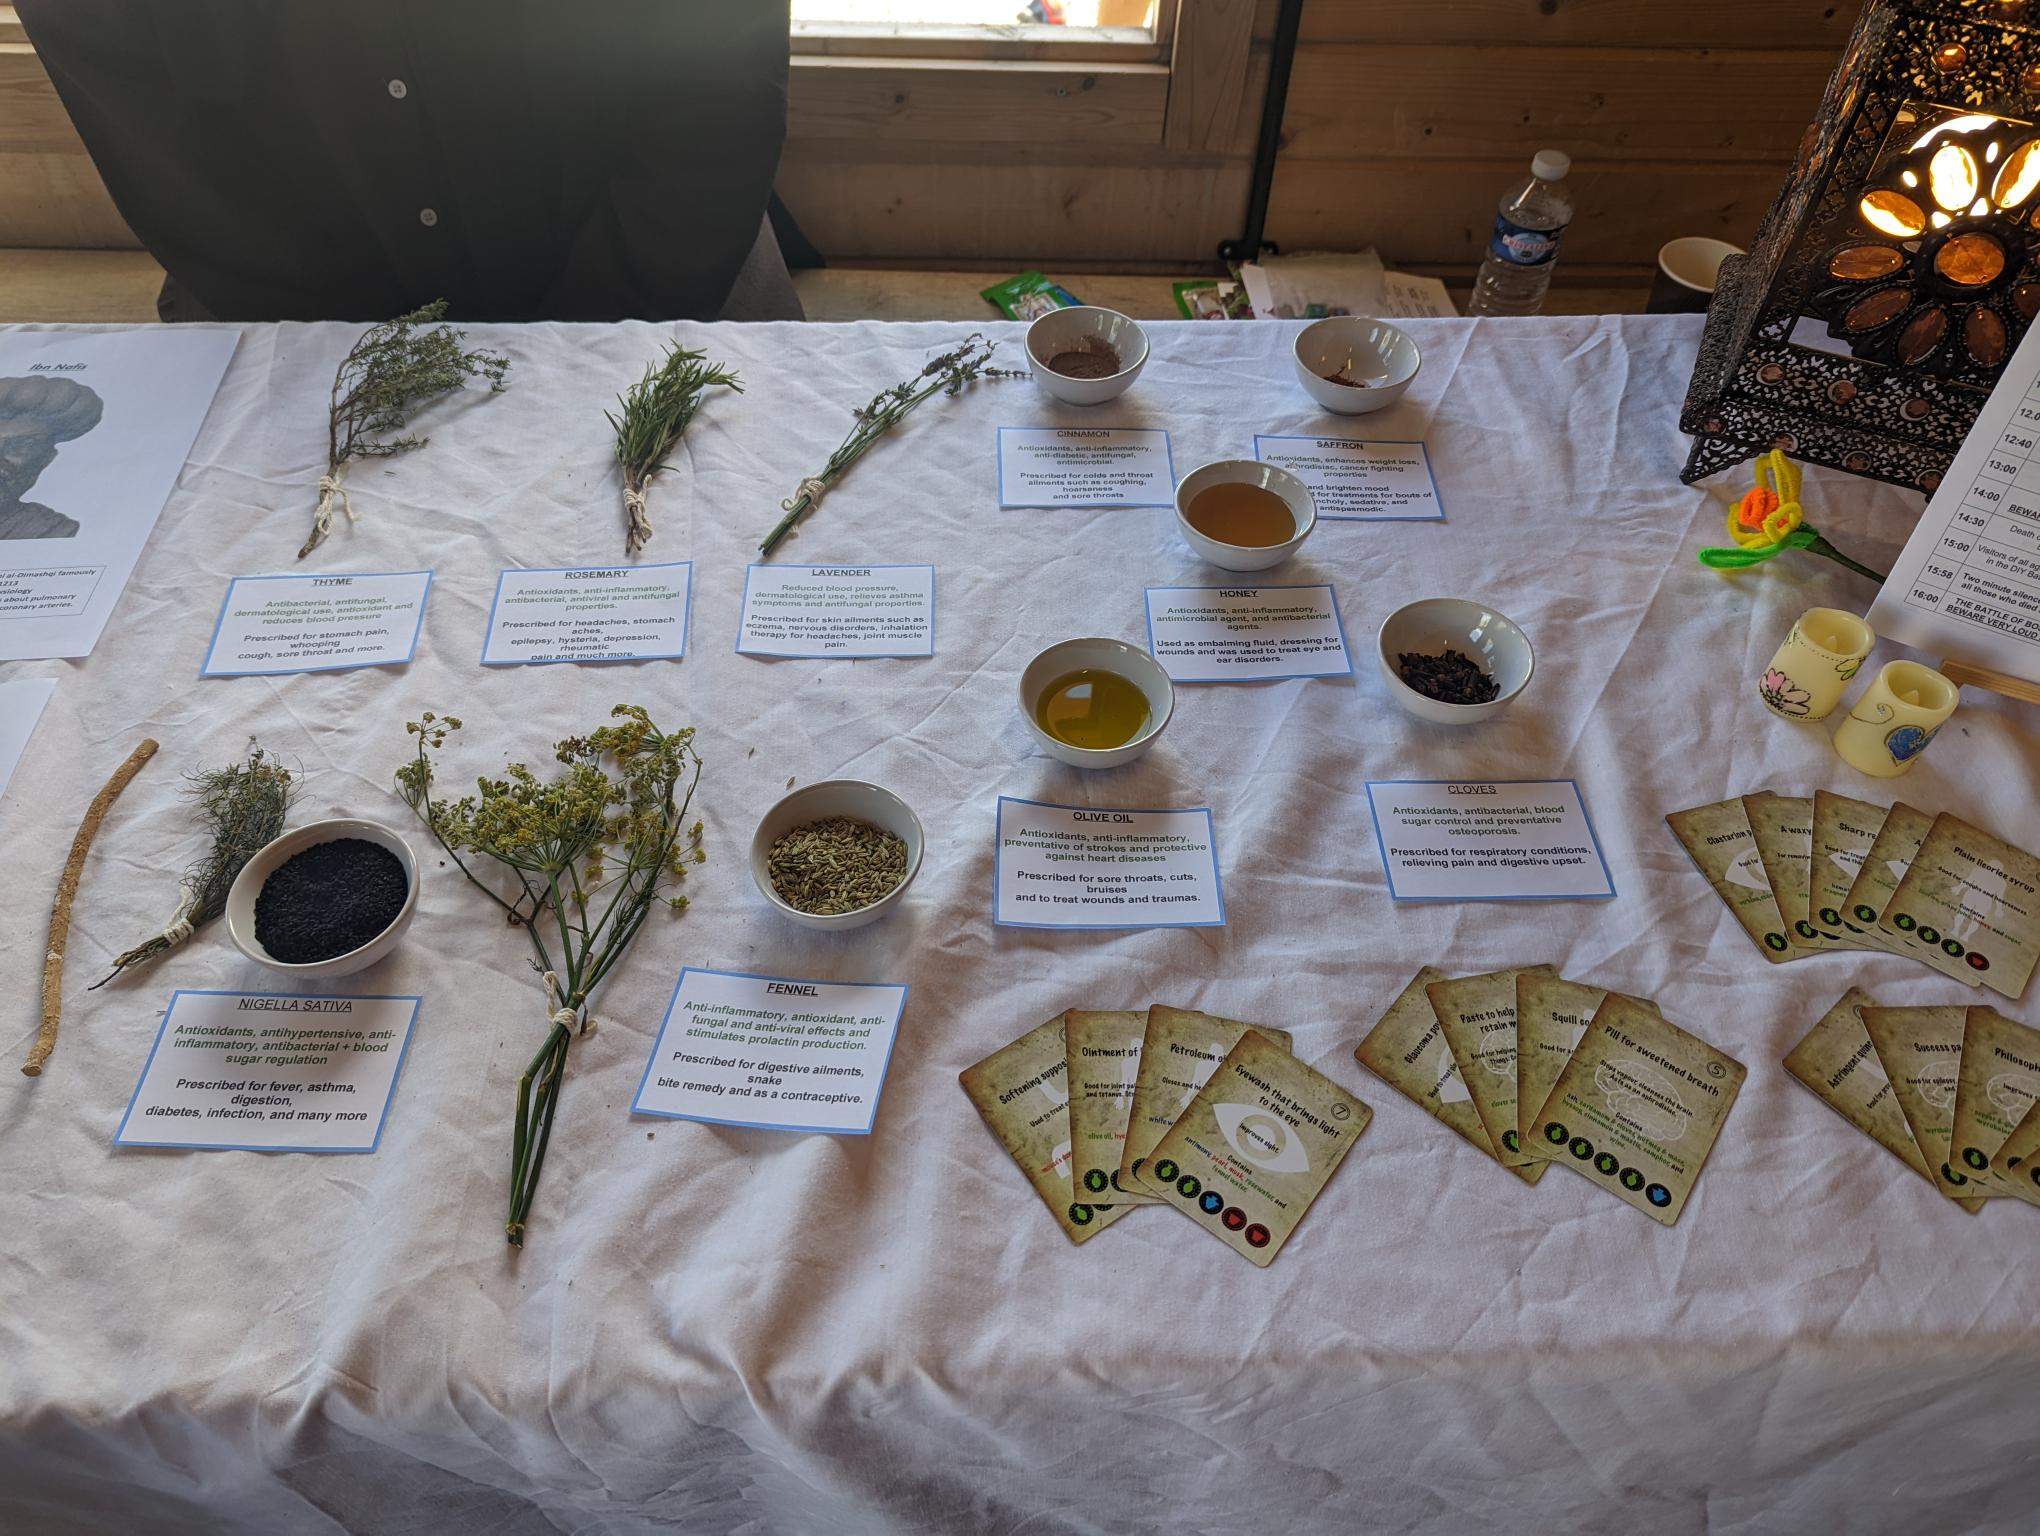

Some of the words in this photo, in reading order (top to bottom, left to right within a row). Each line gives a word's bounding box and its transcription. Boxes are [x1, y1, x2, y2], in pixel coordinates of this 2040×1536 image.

[1316, 440, 1363, 449] SAFFRON
[2003, 433, 2032, 449] 12:40
[1988, 459, 2017, 475] 13:00
[1325, 484, 1363, 493] brighten
[1972, 486, 2000, 502] 14:00
[1958, 512, 1985, 527] 14:30
[2009, 525, 2035, 539] Death
[1943, 537, 1969, 552] 15:00
[1978, 545, 2007, 559] Visitors
[1927, 565, 1953, 579] 15:58
[1986, 557, 1995, 565] in
[1995, 561, 2008, 569] the
[2010, 564, 2026, 576] DIY
[564, 570, 628, 579] ROSEMARY
[311, 578, 353, 586] THYME
[1963, 572, 1980, 583] Two
[1982, 578, 2011, 594] minute
[29, 595, 76, 603] pulmonary
[1911, 589, 1939, 603] 16:00
[1961, 582, 1972, 590] all
[1973, 586, 1997, 599] those
[1999, 594, 2017, 605] who
[2018, 600, 2037, 612] died
[750, 614, 803, 622] Prescribed
[1955, 598, 1972, 608] THE
[1974, 605, 2009, 620] BATTLE
[2011, 616, 2024, 625] OF
[501, 619, 556, 628] Prescribed
[574, 618, 630, 626] headaches,
[632, 616, 675, 624] stomach
[1945, 604, 1986, 623] BEWARE
[1987, 617, 2013, 630] VERY
[2012, 627, 2037, 640] LOUD
[824, 641, 847, 649] pain.
[1197, 640, 1251, 648] embalming
[1279, 638, 1322, 646] dressing
[236, 650, 272, 660] cough,
[301, 646, 333, 656] throat
[334, 645, 355, 654] and
[1233, 655, 1283, 663] disorders.
[1446, 785, 1497, 794] CLOVES
[1072, 812, 1109, 822] OLIVE
[1112, 813, 1133, 823] OIL
[1447, 826, 1520, 837] osteoporosis.
[1839, 822, 1865, 837] Sharp
[1390, 847, 1449, 856] Prescribed
[1450, 847, 1467, 856] for
[1468, 846, 1527, 857] respiratory
[1529, 846, 1591, 855] conditions,
[1016, 871, 1075, 882] Prescribed
[1078, 874, 1094, 883] for
[1123, 873, 1166, 883] throats,
[1169, 872, 1196, 882] cuts,
[1953, 847, 1975, 864] Plain
[1977, 859, 2008, 880] licorice
[2009, 877, 2035, 894] syrup
[1086, 885, 1127, 893] bruises
[1015, 894, 1036, 902] and
[1038, 894, 1050, 903] to
[1052, 895, 1078, 903] treat
[1080, 895, 1124, 904] wounds
[1127, 895, 1149, 903] and
[1151, 895, 1200, 903] traumas.
[766, 982, 819, 996] FENNEL
[237, 999, 300, 1010] NIGELLA
[301, 1000, 354, 1011] SATIVA
[1460, 1014, 1484, 1024] Paste
[1497, 1007, 1515, 1018] help
[1480, 1022, 1508, 1033] retain
[1081, 1047, 1125, 1057] Ointment
[1127, 1048, 1141, 1057] of
[1169, 1044, 1215, 1062] Petroleum
[1914, 1042, 1950, 1052] Success
[672, 1051, 736, 1068] Prescribed
[737, 1059, 755, 1070] for
[756, 1061, 810, 1074] digestive
[811, 1065, 864, 1077] ailments,
[1603, 1025, 1621, 1040] Pill
[1619, 1034, 1636, 1049] for
[1635, 1045, 1688, 1077] sweetened
[1685, 1072, 1721, 1096] breath
[175, 1079, 246, 1090] Prescribed
[247, 1080, 267, 1091] for
[268, 1080, 302, 1093] fever,
[306, 1082, 355, 1094] asthma,
[746, 1075, 782, 1085] snake
[656, 1076, 680, 1089] bite
[681, 1082, 726, 1097] remedy
[728, 1086, 752, 1097] and
[753, 1089, 768, 1098] as
[769, 1091, 778, 1099] a
[780, 1090, 863, 1105] contraceptive.
[999, 1077, 1042, 1105] Softening
[229, 1094, 291, 1108] digestion,
[1234, 1064, 1272, 1092] Eyewash
[1270, 1087, 1293, 1106] that
[1290, 1101, 1319, 1124] brings
[1318, 1119, 1341, 1138] light
[144, 1106, 201, 1119] diabetes,
[206, 1107, 264, 1120] infection,
[268, 1109, 295, 1119] and
[296, 1111, 332, 1122] many
[334, 1112, 368, 1121] more
[1258, 1094, 1269, 1106] to
[1268, 1101, 1285, 1116] the
[1283, 1113, 1301, 1127] eye
[1614, 1111, 1644, 1131] Contains
[1264, 1140, 1280, 1154] sight.
[1226, 1154, 1253, 1175] Contains
